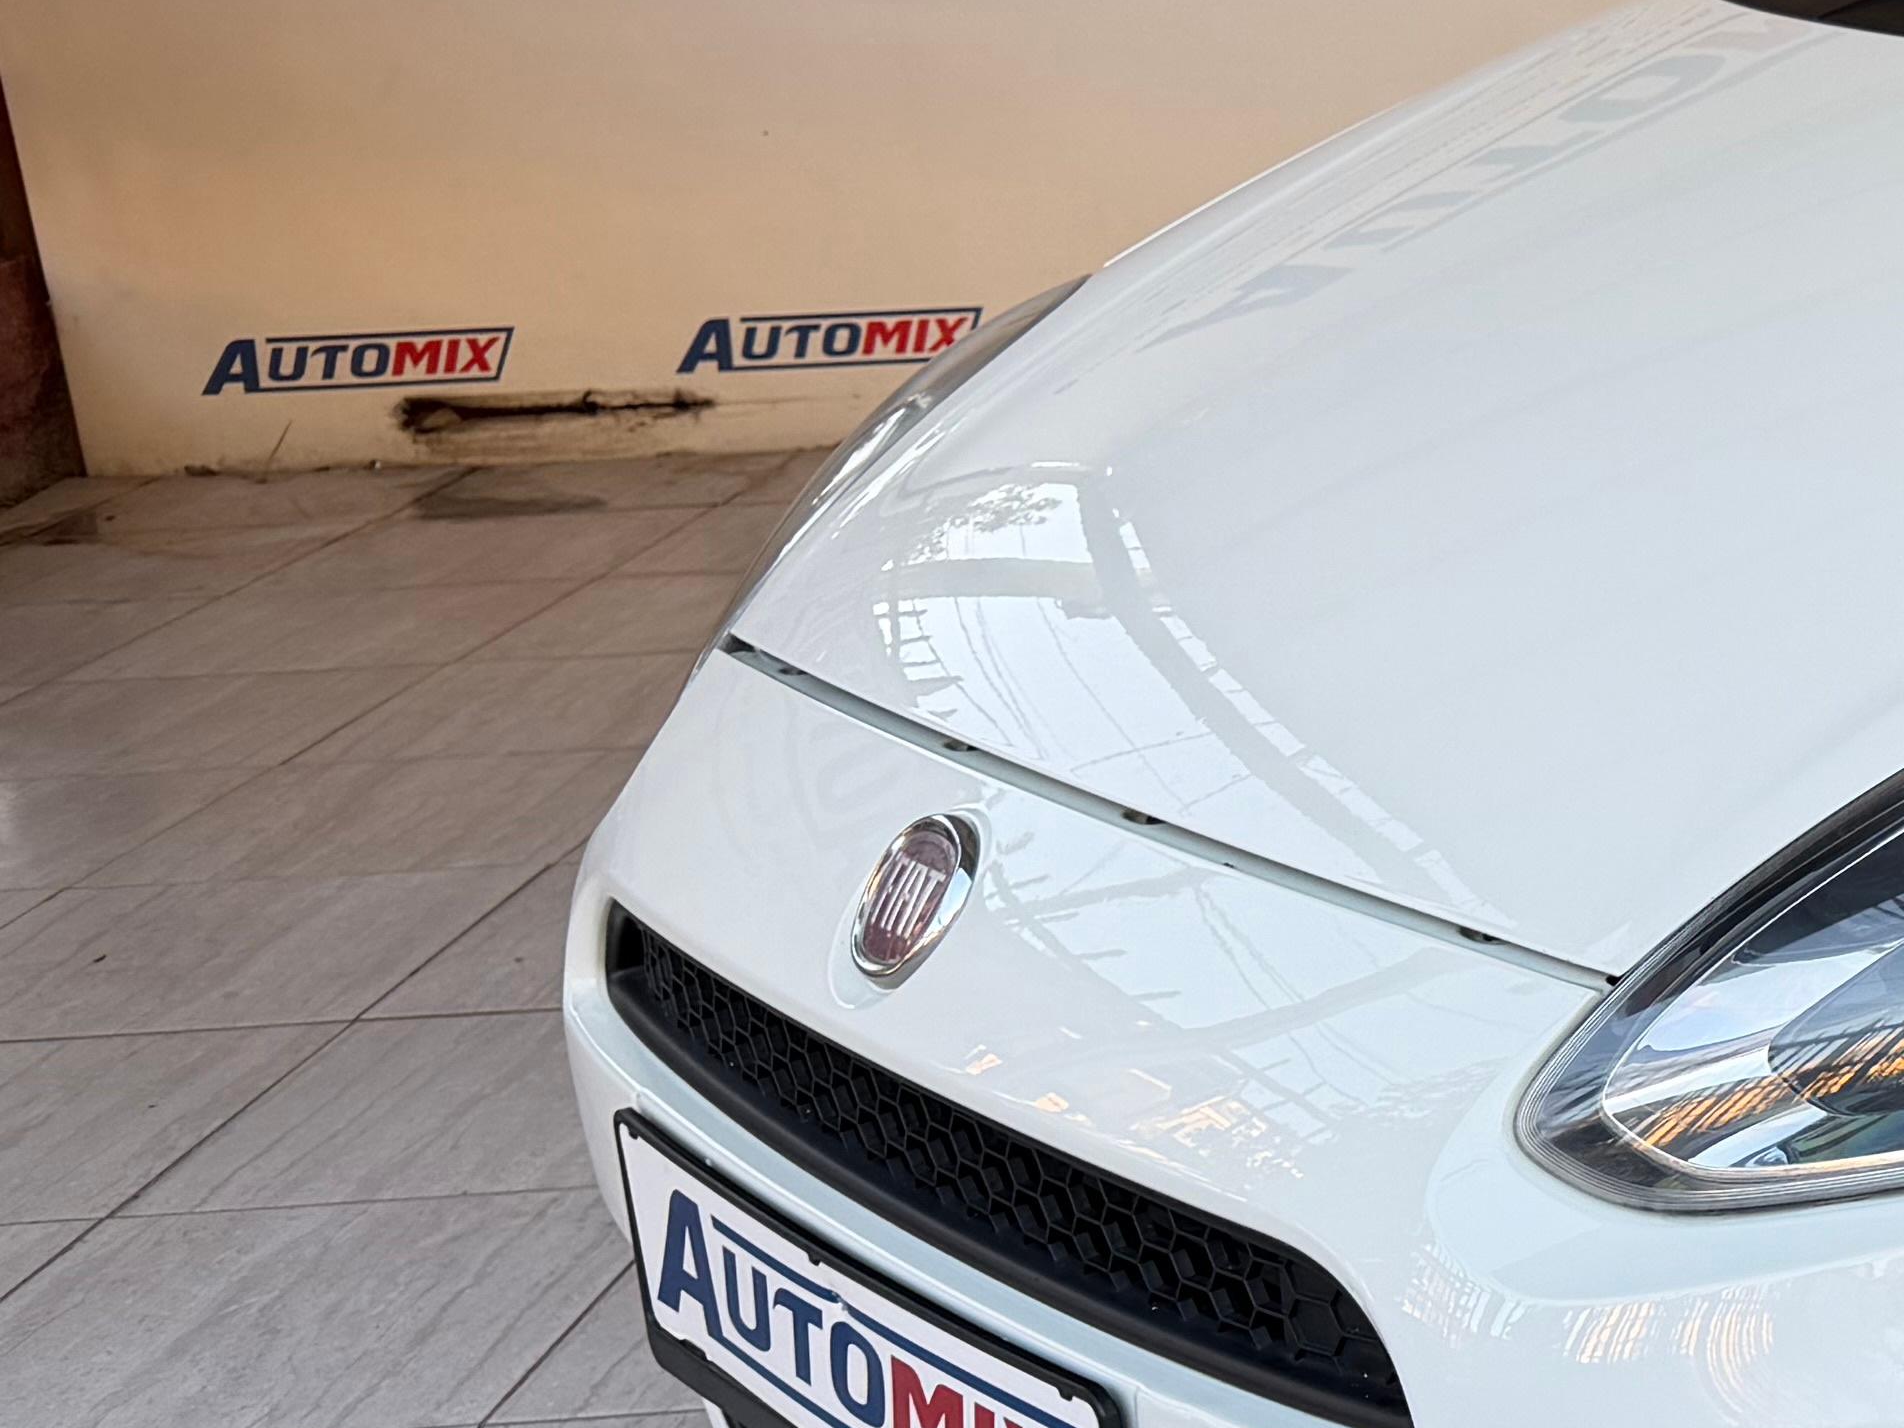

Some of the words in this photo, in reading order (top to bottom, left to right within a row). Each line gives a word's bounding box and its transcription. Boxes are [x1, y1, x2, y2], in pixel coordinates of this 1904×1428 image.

[201, 336, 501, 396] AUTOMIX
[676, 316, 969, 374] AUTOMIX
[871, 852, 946, 940] FIAT
